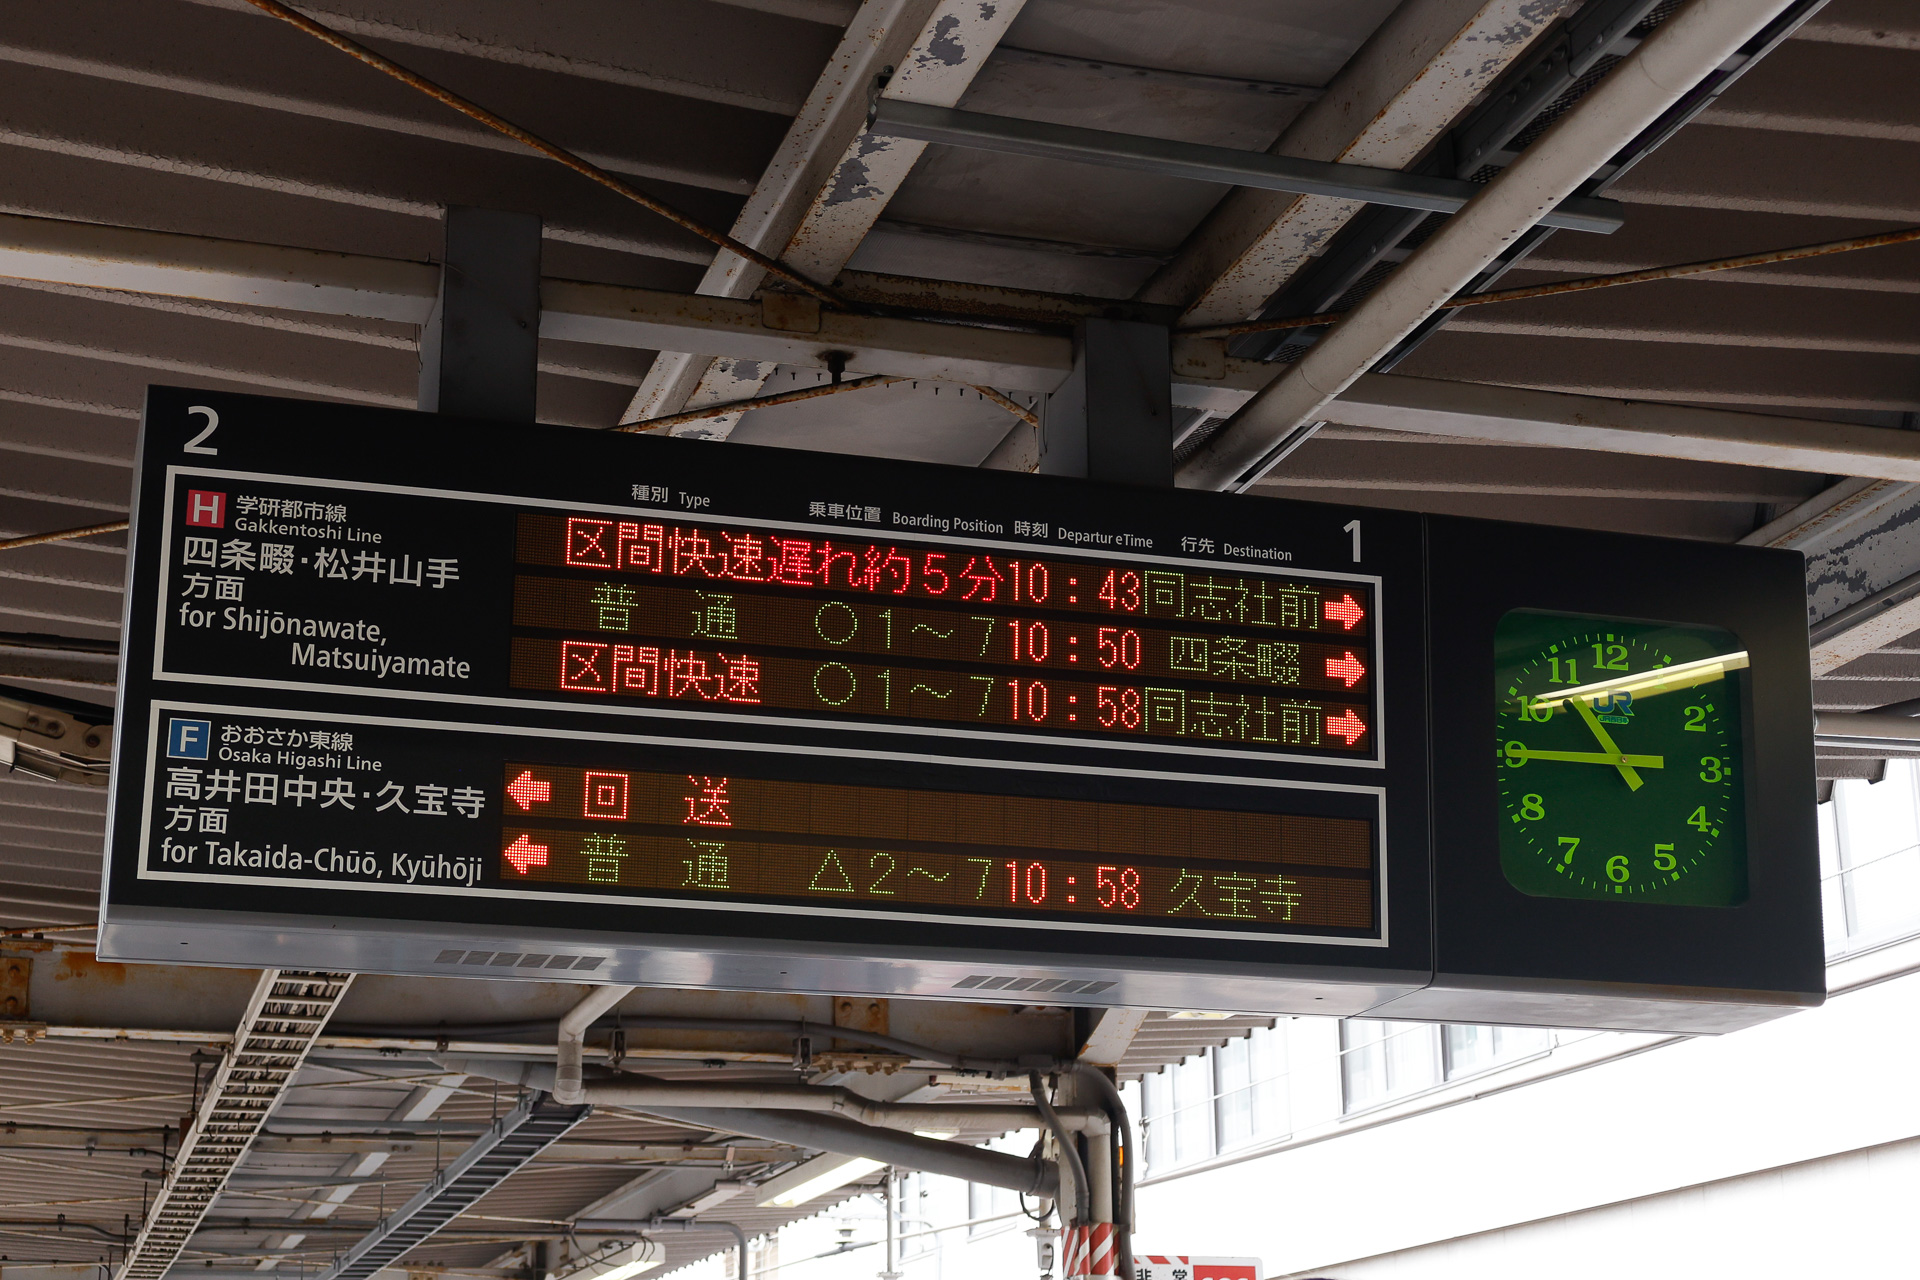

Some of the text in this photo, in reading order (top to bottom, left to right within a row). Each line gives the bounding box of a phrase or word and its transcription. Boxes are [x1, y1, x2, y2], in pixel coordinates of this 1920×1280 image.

[183, 404, 220, 457] 2
[629, 483, 670, 503] 種別
[677, 490, 712, 510] Type
[192, 493, 220, 525] H
[235, 494, 348, 524] 学研都市線
[808, 500, 882, 524] 乗車位置
[891, 510, 1005, 535] Boarding Position
[234, 517, 384, 545] Gakkentoshi Line
[1013, 520, 1049, 540] 時刻
[1341, 518, 1363, 564] 1
[1180, 534, 1216, 556] 行先
[1222, 542, 1294, 563] Destination
[180, 571, 246, 602] 方面
[1144, 570, 1320, 630] 同志社前
[178, 602, 217, 628] for
[290, 641, 472, 680] Matsuiyamate
[1170, 635, 1300, 685] 四条畷
[1547, 657, 1581, 684] 11
[1592, 643, 1629, 671] 12
[561, 641, 761, 703] 区間快速
[1144, 687, 1321, 745] 同志社前
[1517, 695, 1553, 722] 10
[1684, 706, 1707, 732] 2
[179, 725, 199, 753] F
[219, 724, 354, 751] おおさか東線
[217, 743, 383, 772] Ōsaka Higashi Line
[1504, 741, 1528, 768] 9
[1700, 757, 1723, 783] 3
[163, 804, 230, 835] 方面
[1520, 794, 1546, 821] 8
[1687, 806, 1712, 832] 4
[160, 837, 198, 865] for
[390, 852, 484, 888] Kyūhōji
[1558, 837, 1580, 864] 7
[1653, 843, 1677, 871] 5
[1605, 856, 1630, 883] 6
[1167, 866, 1302, 921] 久宝寺
